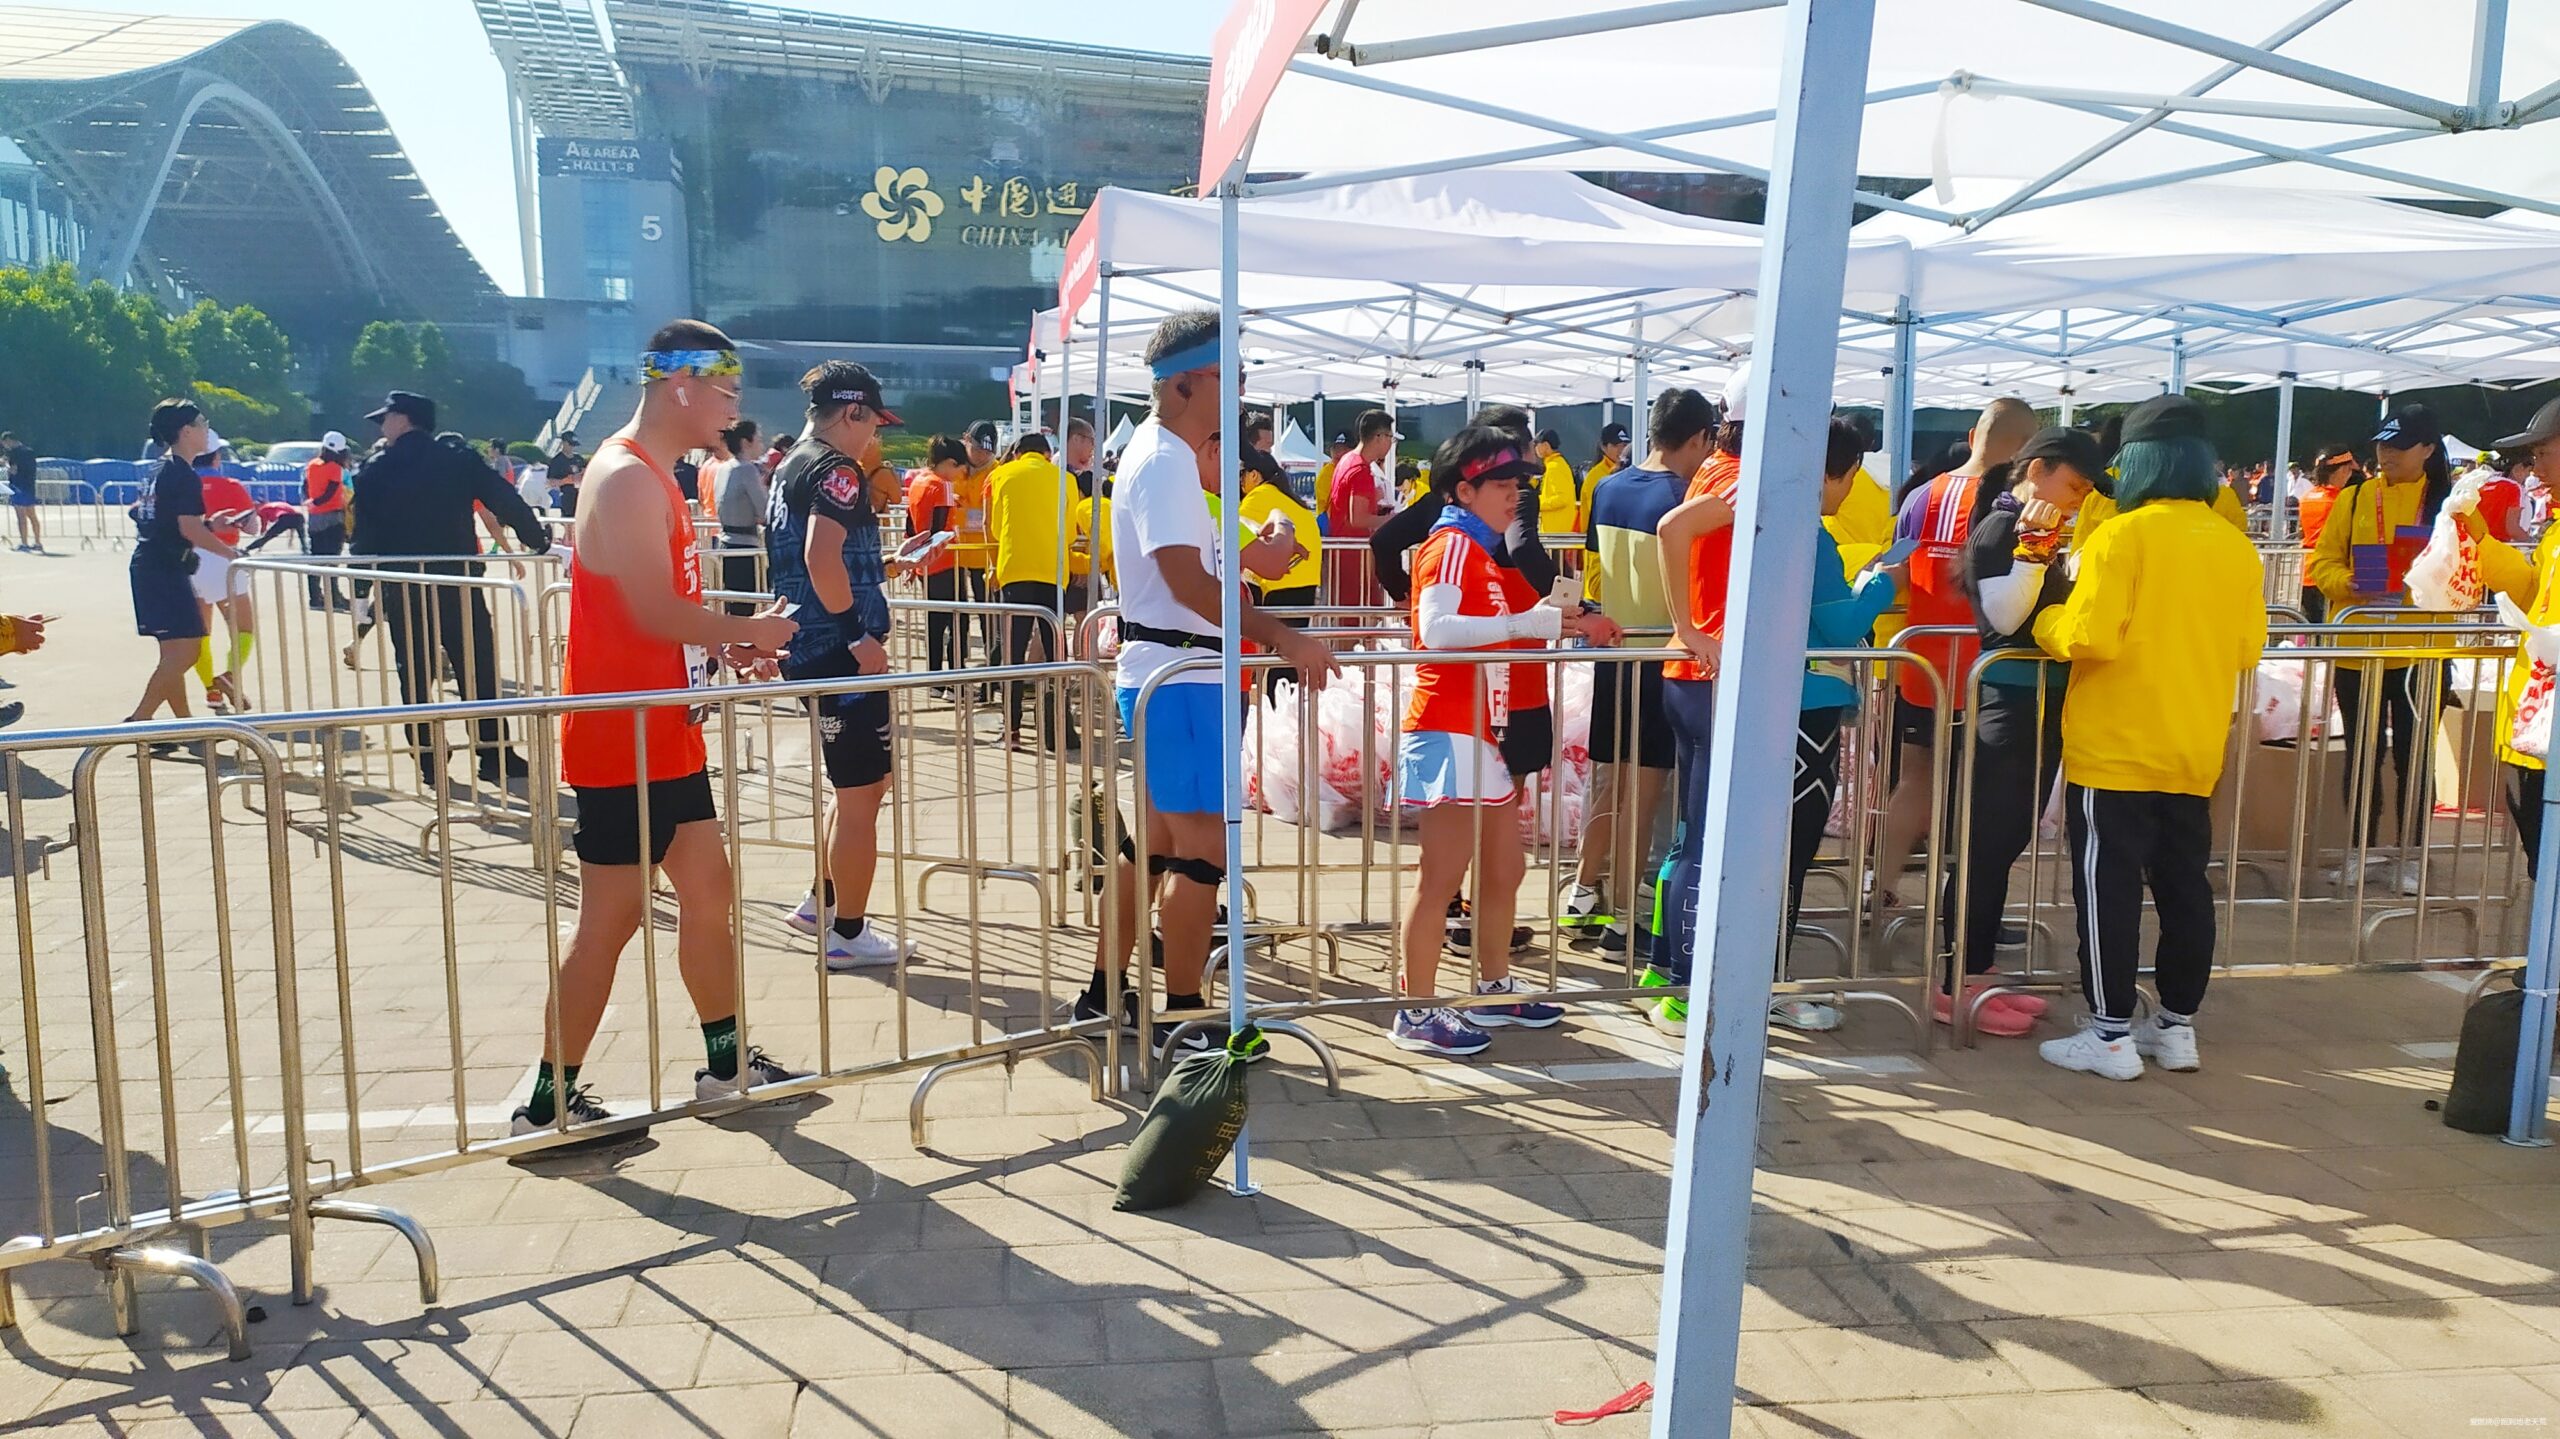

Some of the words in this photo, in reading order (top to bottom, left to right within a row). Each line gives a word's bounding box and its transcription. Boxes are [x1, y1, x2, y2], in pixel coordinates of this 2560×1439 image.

[594, 147, 628, 159] AREA
[630, 148, 640, 160] A
[573, 160, 610, 172] HALL
[641, 215, 663, 241] 5
[962, 226, 1040, 248] CHINA
